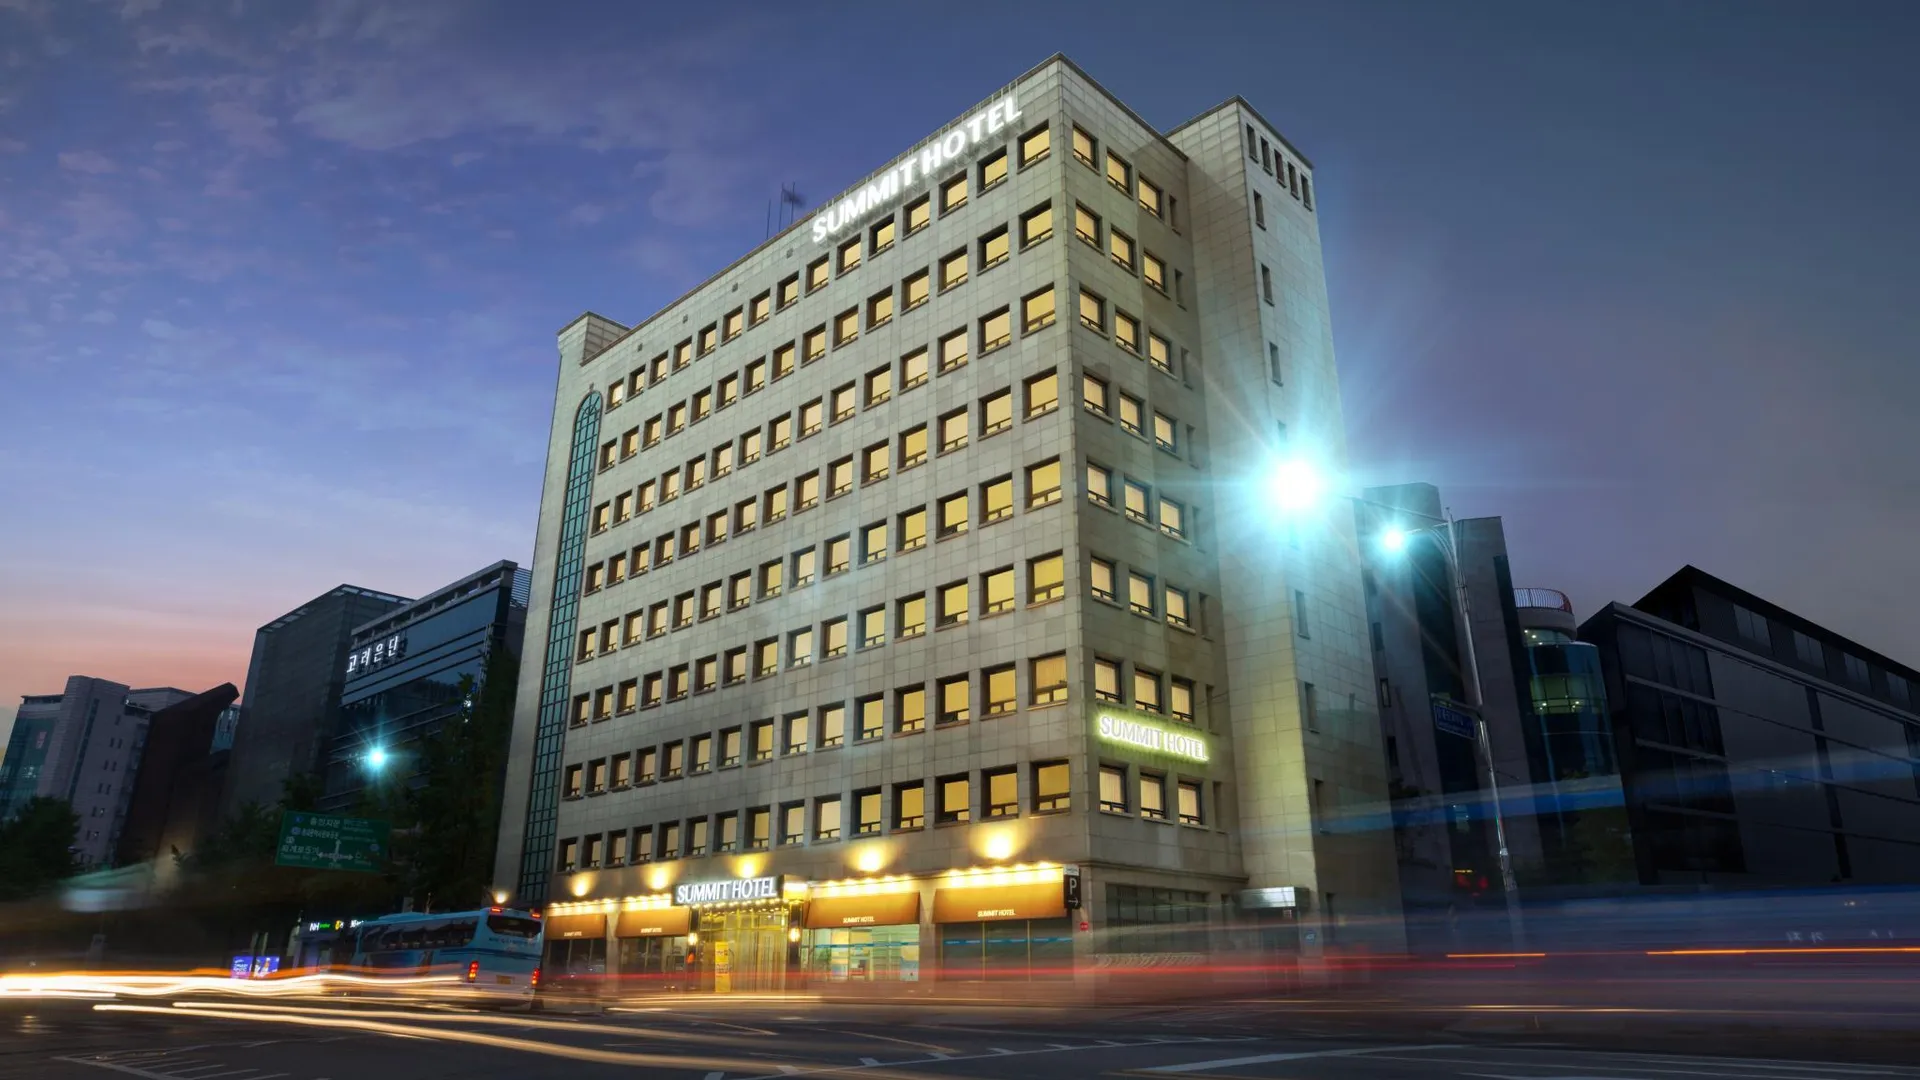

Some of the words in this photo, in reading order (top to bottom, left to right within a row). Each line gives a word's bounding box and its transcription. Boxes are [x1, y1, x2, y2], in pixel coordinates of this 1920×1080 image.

[812, 158, 917, 243] SUMMIT
[921, 96, 1022, 176] HOTEL
[346, 635, 398, 673] 고려은단
[1100, 715, 1163, 749] SUMMIT
[1164, 732, 1209, 761] HOTEL
[677, 881, 732, 903] SUMMIT
[732, 876, 778, 899] HOTEL
[1070, 878, 1077, 895] P
